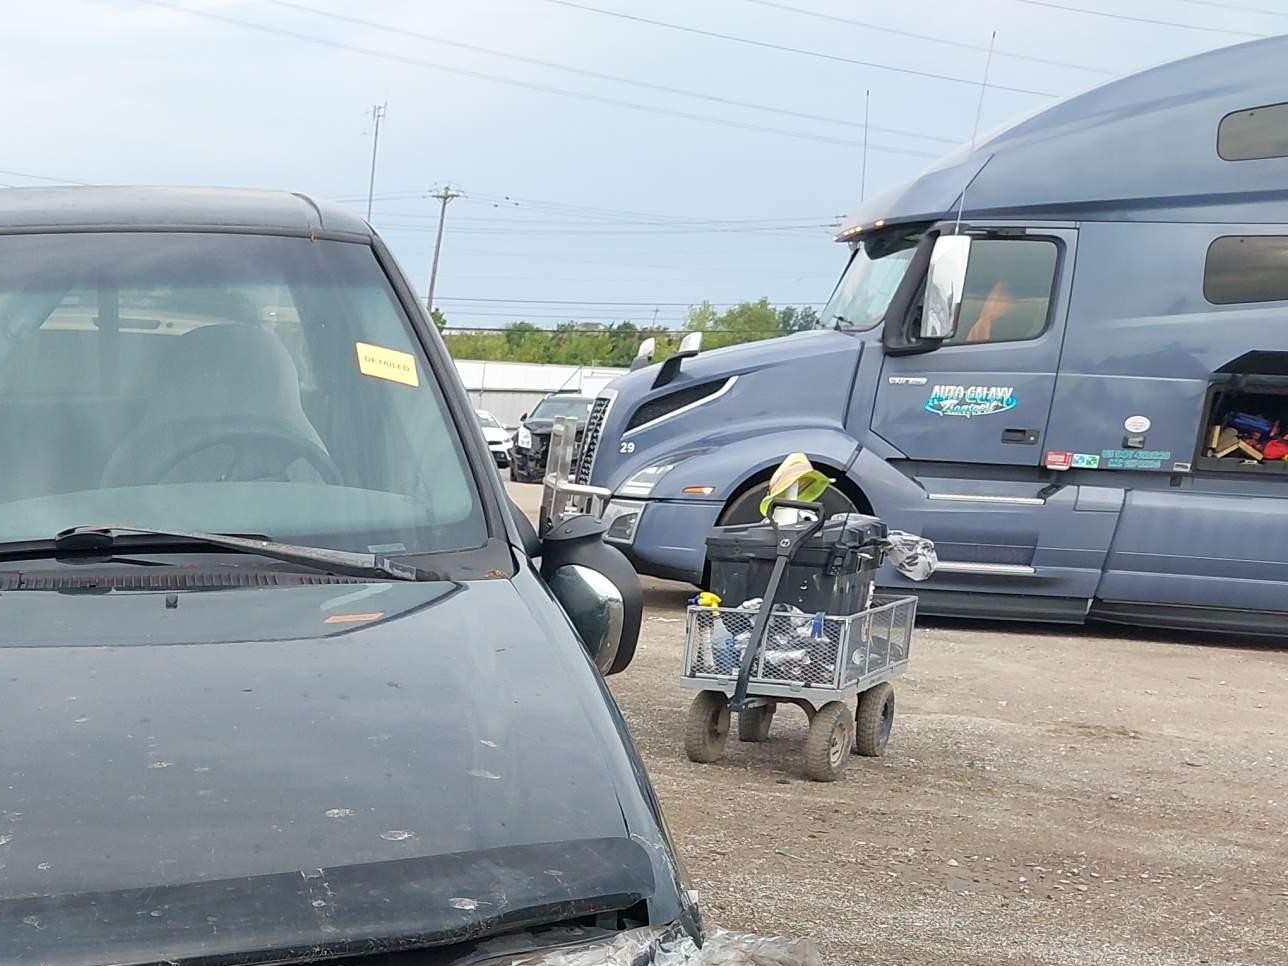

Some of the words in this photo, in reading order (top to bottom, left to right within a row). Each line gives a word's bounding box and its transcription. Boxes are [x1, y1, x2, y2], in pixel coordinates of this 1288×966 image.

[930, 385, 965, 400] AUTO
[965, 386, 1014, 406] GALAXY
[619, 442, 635, 453] 29
